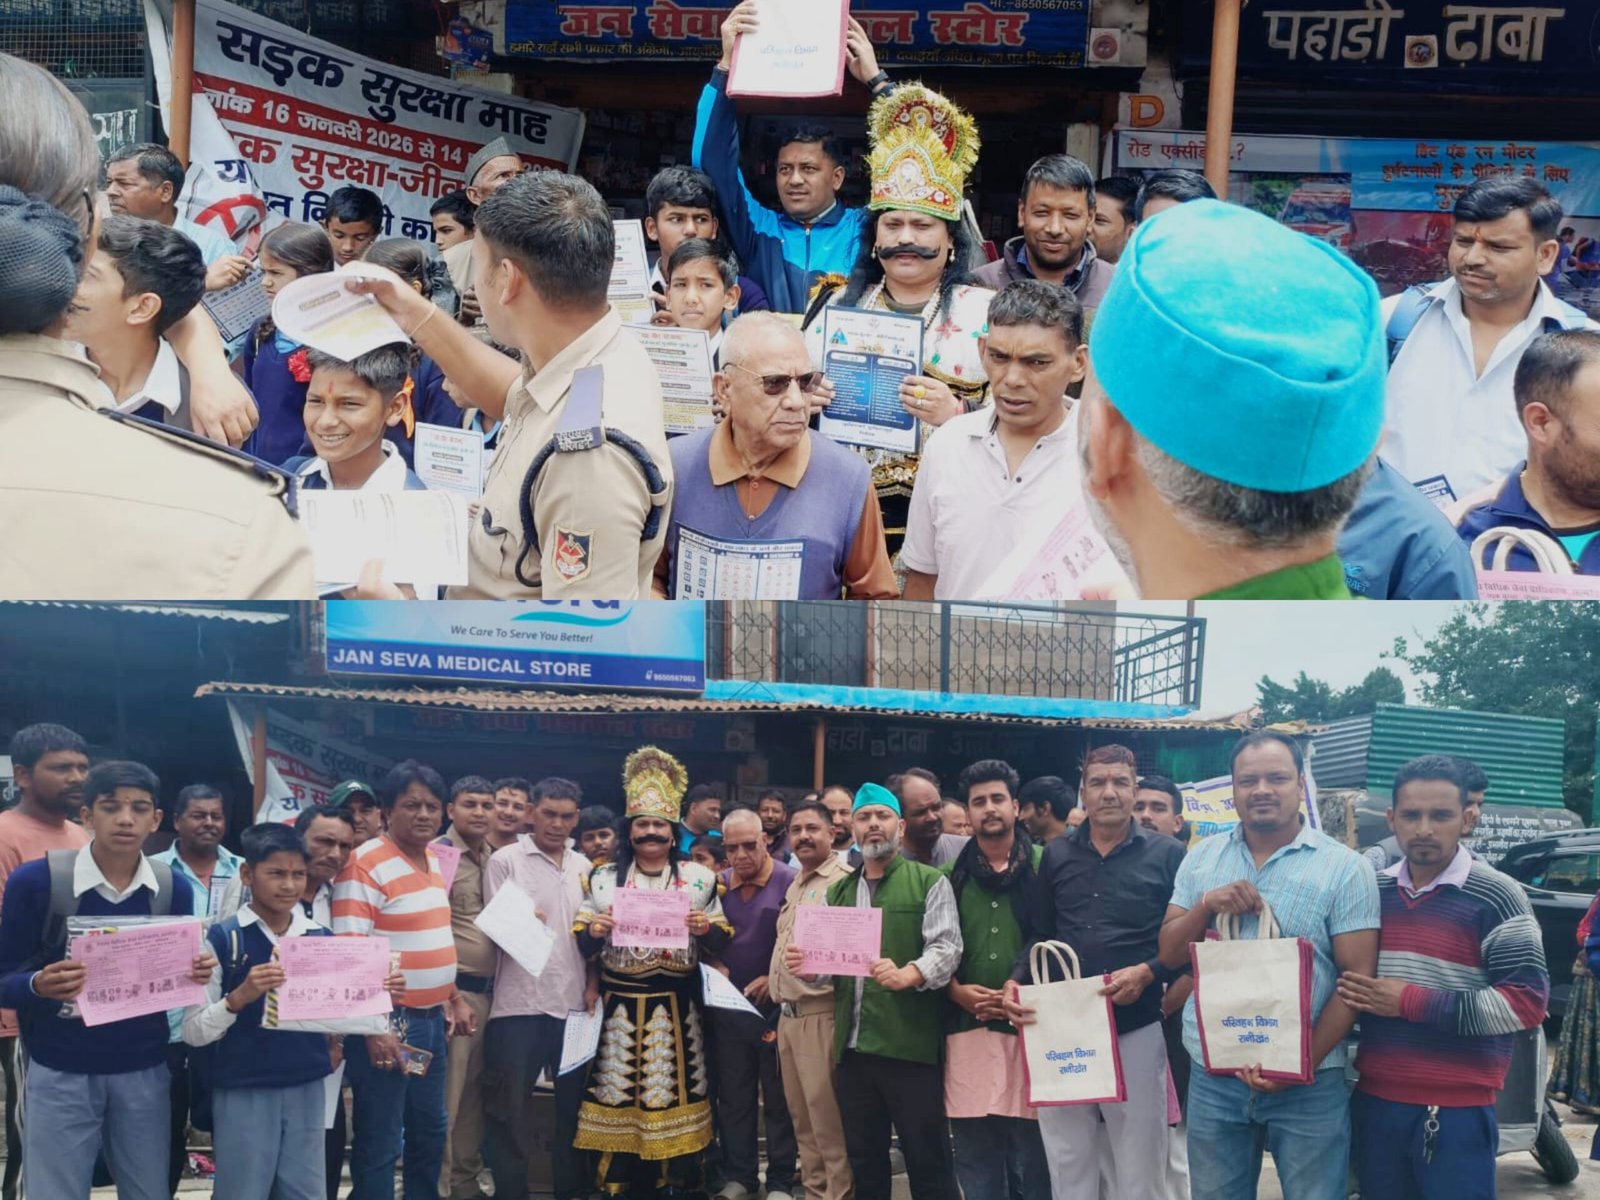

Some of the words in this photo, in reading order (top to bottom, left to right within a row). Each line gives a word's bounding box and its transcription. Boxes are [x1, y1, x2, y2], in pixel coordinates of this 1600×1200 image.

[560, 6, 636, 38] जन
[928, 3, 1029, 46] स्टोर
[216, 20, 354, 87] सड़क
[360, 68, 474, 123] सुरक्षा
[478, 99, 552, 145] माह
[1129, 94, 1165, 128] D
[262, 100, 290, 124] 16
[297, 109, 362, 143] जनवरी
[366, 129, 414, 154] 2026
[419, 137, 436, 160] से
[441, 144, 463, 164] 14
[1126, 137, 1153, 157] रोड
[1416, 143, 1439, 158] हिट
[1475, 146, 1494, 159] रन
[1502, 143, 1537, 160] मोटर
[292, 143, 466, 200] सुरक्षा-जीव
[1450, 163, 1465, 179] के
[1544, 165, 1571, 183] लिए
[450, 625, 467, 635] We
[469, 626, 494, 637] Care
[496, 628, 508, 638] To
[509, 629, 538, 640] Serve
[540, 631, 558, 642] You
[560, 633, 593, 643] Better!
[333, 649, 374, 665] JAN
[380, 651, 432, 669] SEVA
[437, 655, 525, 674] MEDICAL
[530, 660, 592, 677] STORE
